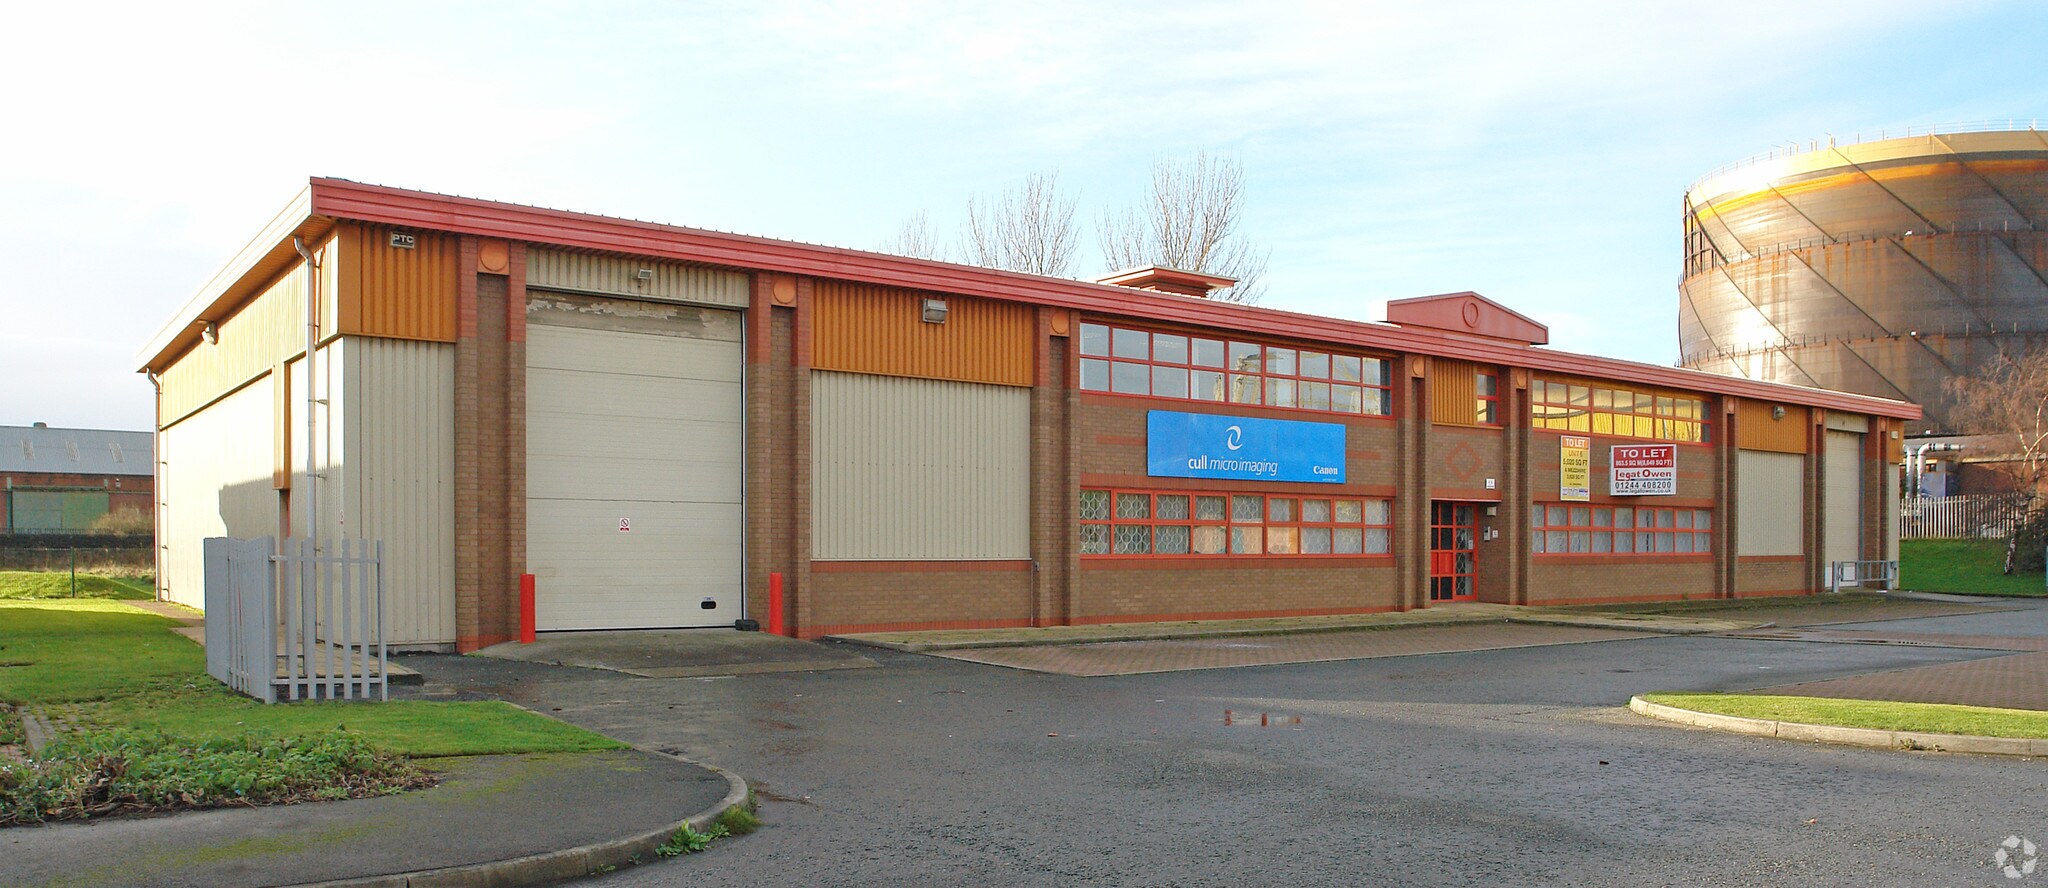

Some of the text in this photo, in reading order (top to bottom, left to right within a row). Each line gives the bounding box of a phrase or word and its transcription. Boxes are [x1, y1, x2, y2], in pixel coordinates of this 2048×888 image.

[392, 234, 414, 243] PTC
[1565, 438, 1585, 448] TO LET
[1620, 448, 1667, 458] TO LET
[1188, 455, 1208, 470] cull
[1313, 465, 1338, 475] Canon
[1615, 469, 1672, 481] Legat Owen
[1642, 481, 1672, 489] 408200
